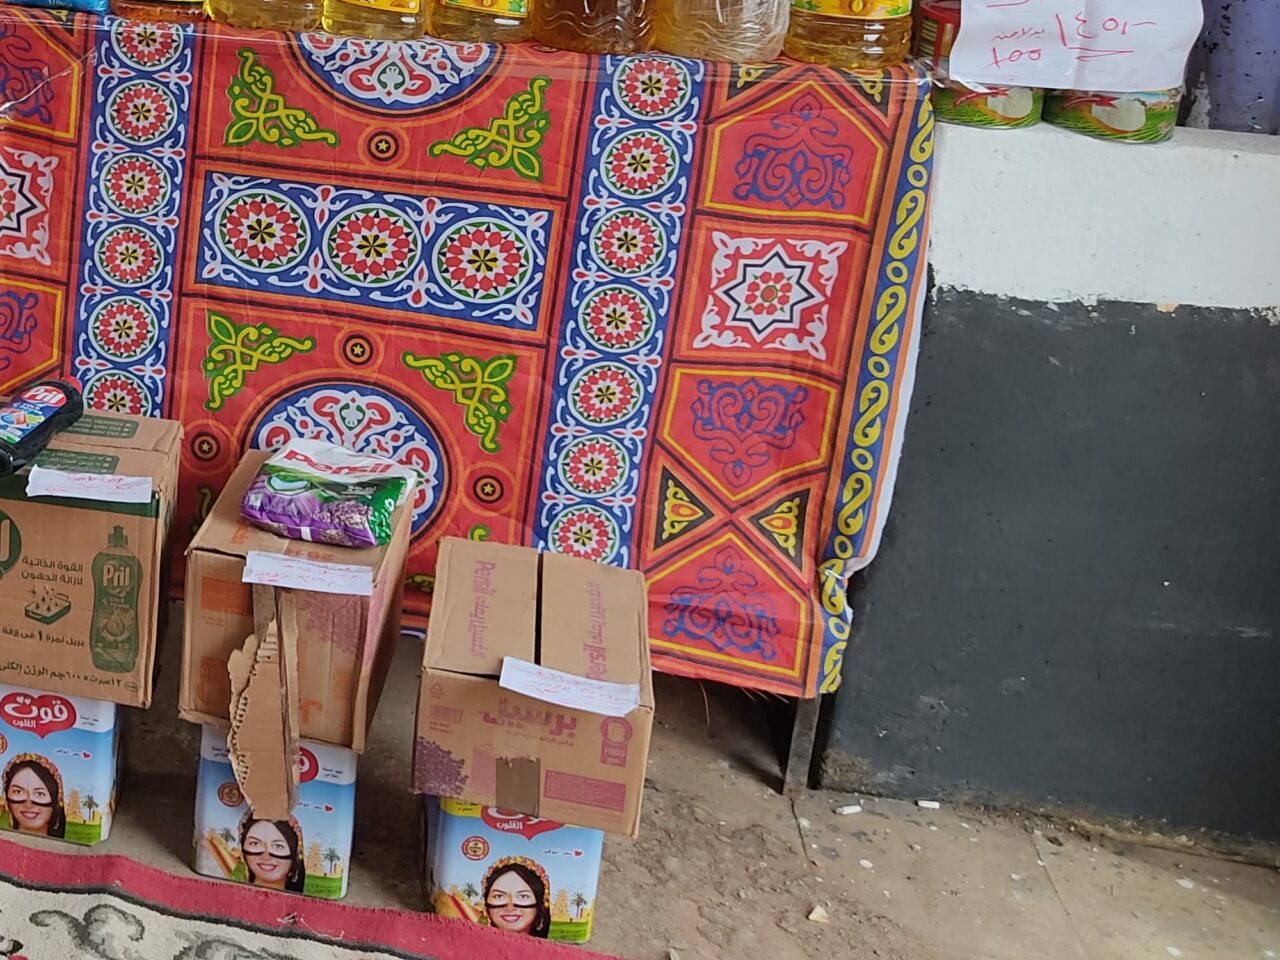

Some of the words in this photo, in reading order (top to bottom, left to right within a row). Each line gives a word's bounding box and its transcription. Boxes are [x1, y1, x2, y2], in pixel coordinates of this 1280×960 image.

[21, 386, 66, 404] Pril
[283, 449, 394, 475] Persil
[57, 561, 83, 573] القوة
[103, 564, 130, 587] Pril
[4, 696, 68, 724] قوت
[13, 719, 37, 728] القلوب
